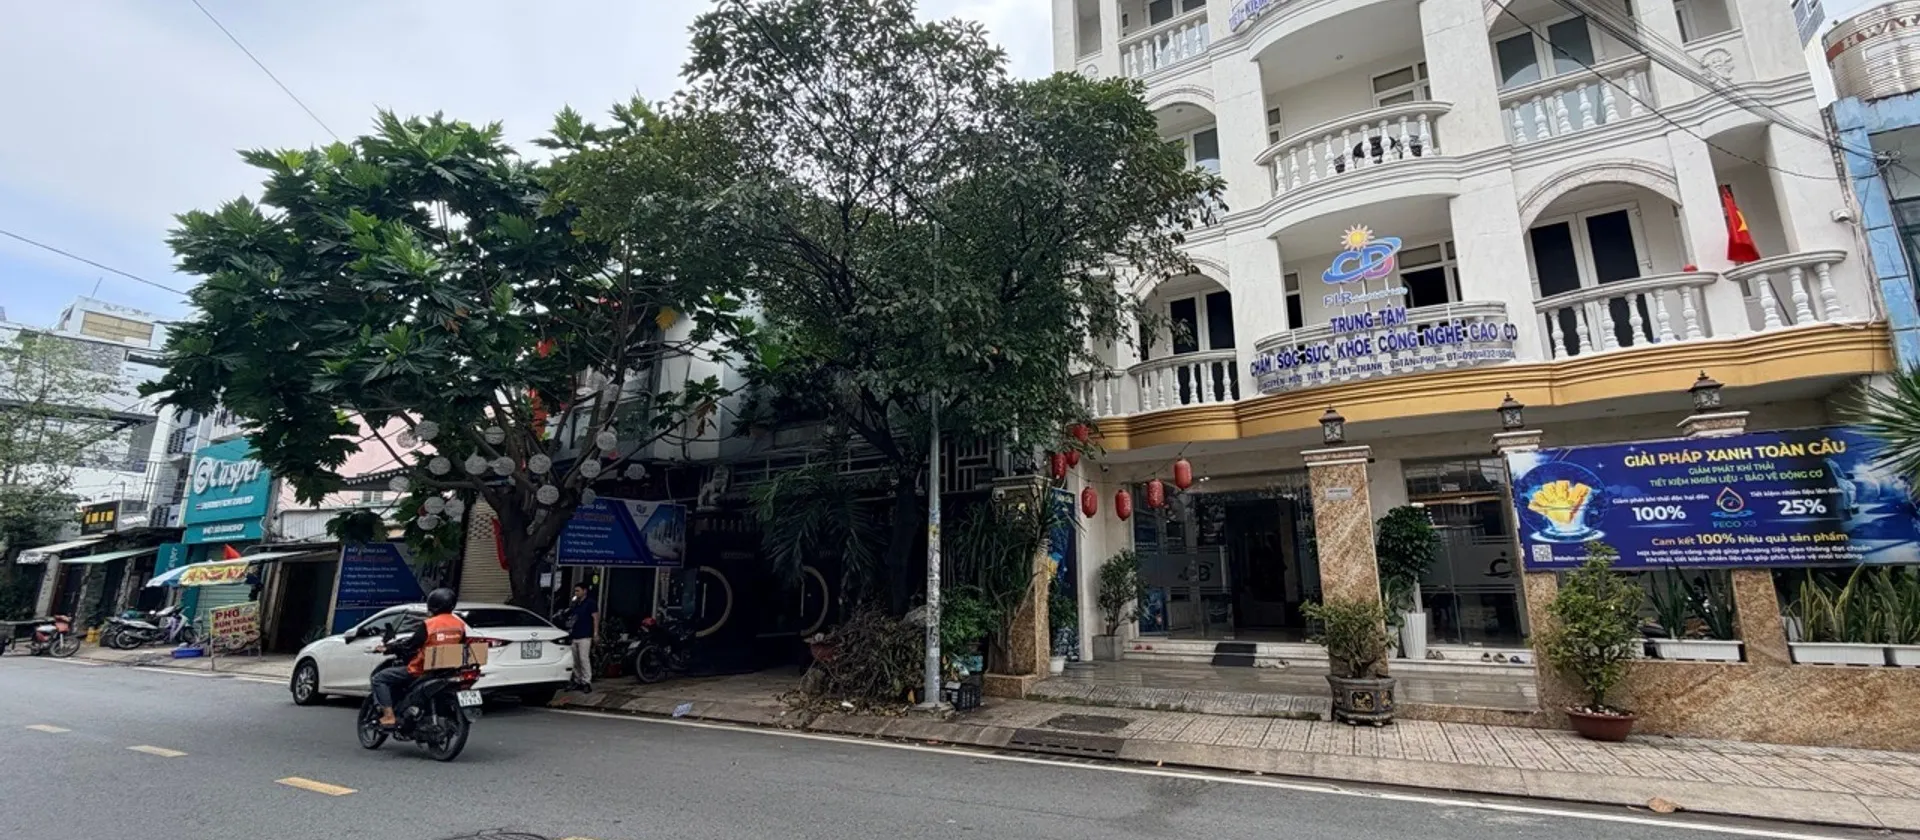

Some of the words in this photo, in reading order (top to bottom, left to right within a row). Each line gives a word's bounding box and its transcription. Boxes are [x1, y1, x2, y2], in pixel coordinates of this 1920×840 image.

[1331, 312, 1374, 334] TRUNG
[1379, 303, 1407, 326] TÂM
[1305, 342, 1330, 364] SỨC
[1378, 329, 1418, 352] CÔNG
[1424, 319, 1464, 347] NGHỆ
[1470, 322, 1498, 341] CAO
[1503, 322, 1518, 341] CD
[1624, 450, 1655, 467] GIẢI
[1658, 448, 1702, 465] PHÁP
[1705, 446, 1753, 462] XANH
[1755, 441, 1805, 458] TOÀN
[1808, 437, 1846, 455] CẦU
[209, 459, 262, 493] Casper
[1650, 477, 1667, 487] TIẾT
[1669, 476, 1689, 487] KIỆM
[1691, 475, 1717, 485] NHIÊN
[1718, 474, 1738, 485] LIỆU
[1745, 471, 1764, 482] BẢO
[1766, 470, 1778, 481] VỆ
[1780, 469, 1807, 480] ĐỘNG
[1809, 468, 1824, 478] CƠ
[1688, 465, 1710, 475] GIẢM
[1712, 463, 1735, 474] PHÁT
[1737, 462, 1752, 472] KHÍ
[1753, 461, 1775, 470] THẢI
[1632, 505, 1687, 521] 100%
[1777, 498, 1827, 516] 25%
[1651, 537, 1676, 546] Cam
[1677, 536, 1695, 545] kết
[1696, 532, 1736, 545] 100%
[1738, 533, 1763, 545] hiệu
[1765, 533, 1787, 544] quả
[1789, 532, 1811, 542] sản
[1813, 531, 1849, 543] phẩm
